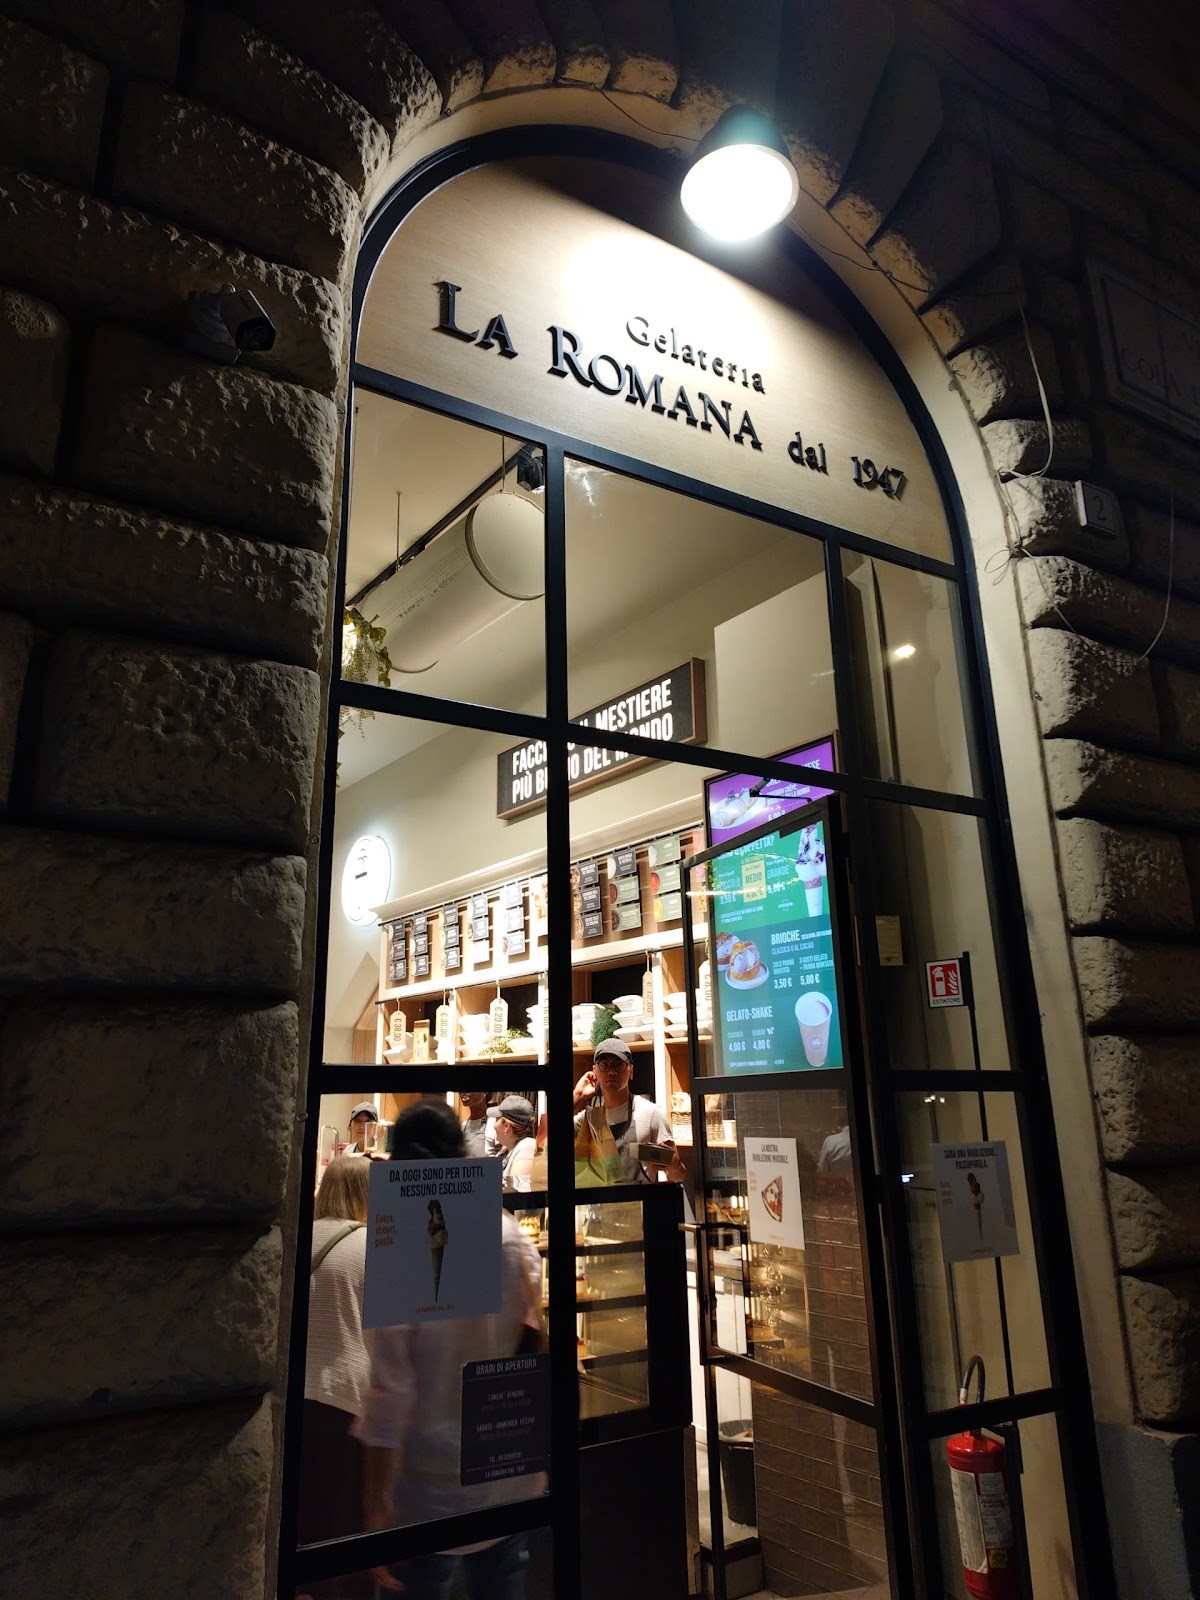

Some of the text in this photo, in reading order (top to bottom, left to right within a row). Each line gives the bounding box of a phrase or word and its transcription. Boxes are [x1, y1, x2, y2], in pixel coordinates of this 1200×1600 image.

[625, 315, 766, 395] Gelateria
[433, 280, 907, 500] LA ROMANA dal 1947
[1093, 495, 1107, 522] 2
[595, 678, 673, 733] MESTIERE
[512, 770, 534, 804] PIÙ
[583, 747, 611, 774] DEL
[745, 872, 763, 884] MEDIO
[766, 865, 790, 879] GRANDE
[771, 929, 800, 945] BRIOCHE
[932, 997, 961, 1005] ESTINTORE
[726, 1006, 774, 1022] GELATO-SHAKE
[389, 1165, 485, 1183] DA OGGI SONO PER TUTTI.
[400, 1181, 475, 1198] NESSUNO ESCLUSO.
[475, 1358, 537, 1376] ORARI DI APERTURA
